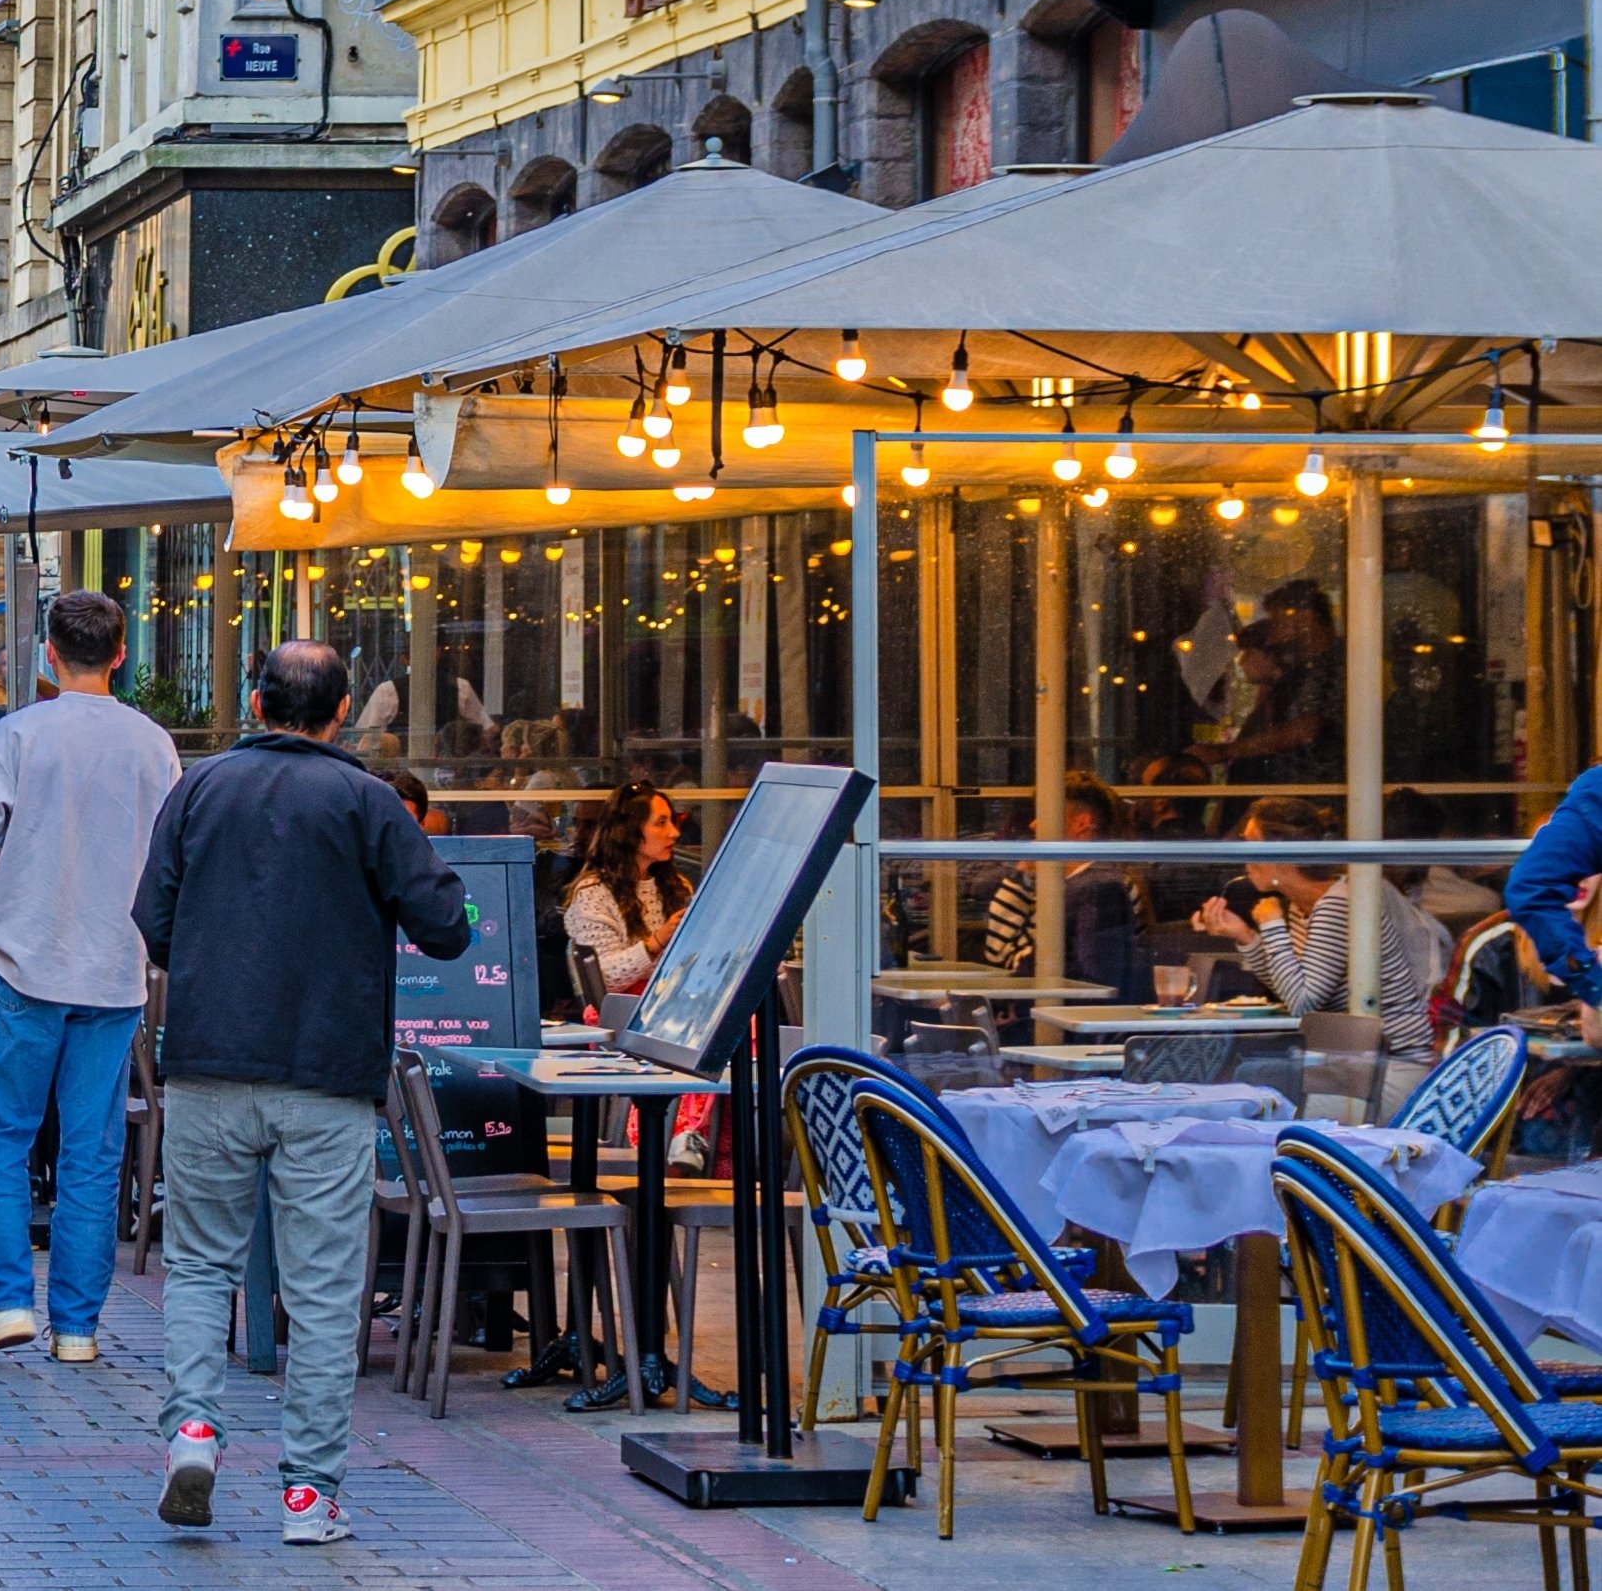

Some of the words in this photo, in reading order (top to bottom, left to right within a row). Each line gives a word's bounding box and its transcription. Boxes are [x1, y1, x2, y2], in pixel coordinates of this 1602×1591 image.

[252, 42, 271, 54] Rue
[245, 60, 278, 72] NEUVE
[466, 1020, 490, 1030] vous
